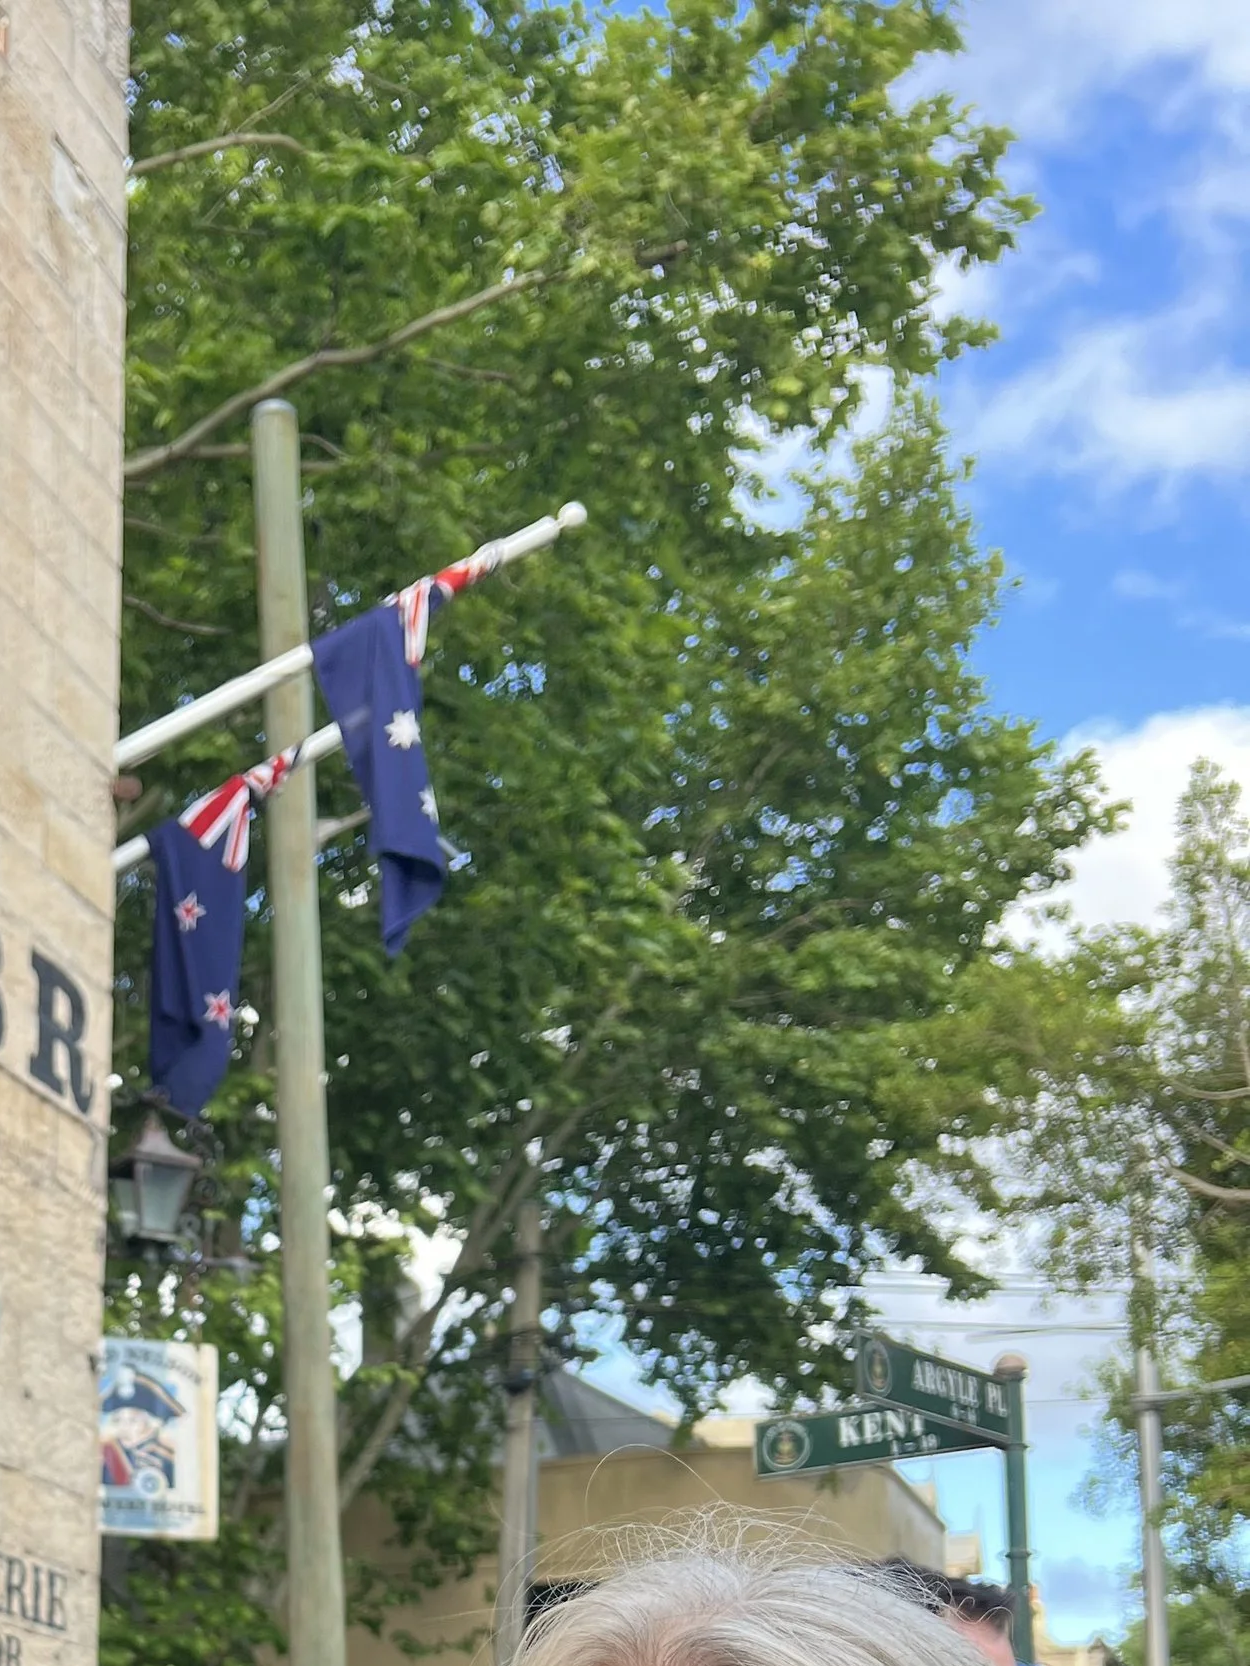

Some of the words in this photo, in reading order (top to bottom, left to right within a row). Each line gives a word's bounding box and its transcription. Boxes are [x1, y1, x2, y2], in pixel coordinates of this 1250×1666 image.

[911, 1358, 979, 1408] ARGYLE
[984, 1381, 1008, 1418] PL
[838, 1410, 924, 1448] KENT
